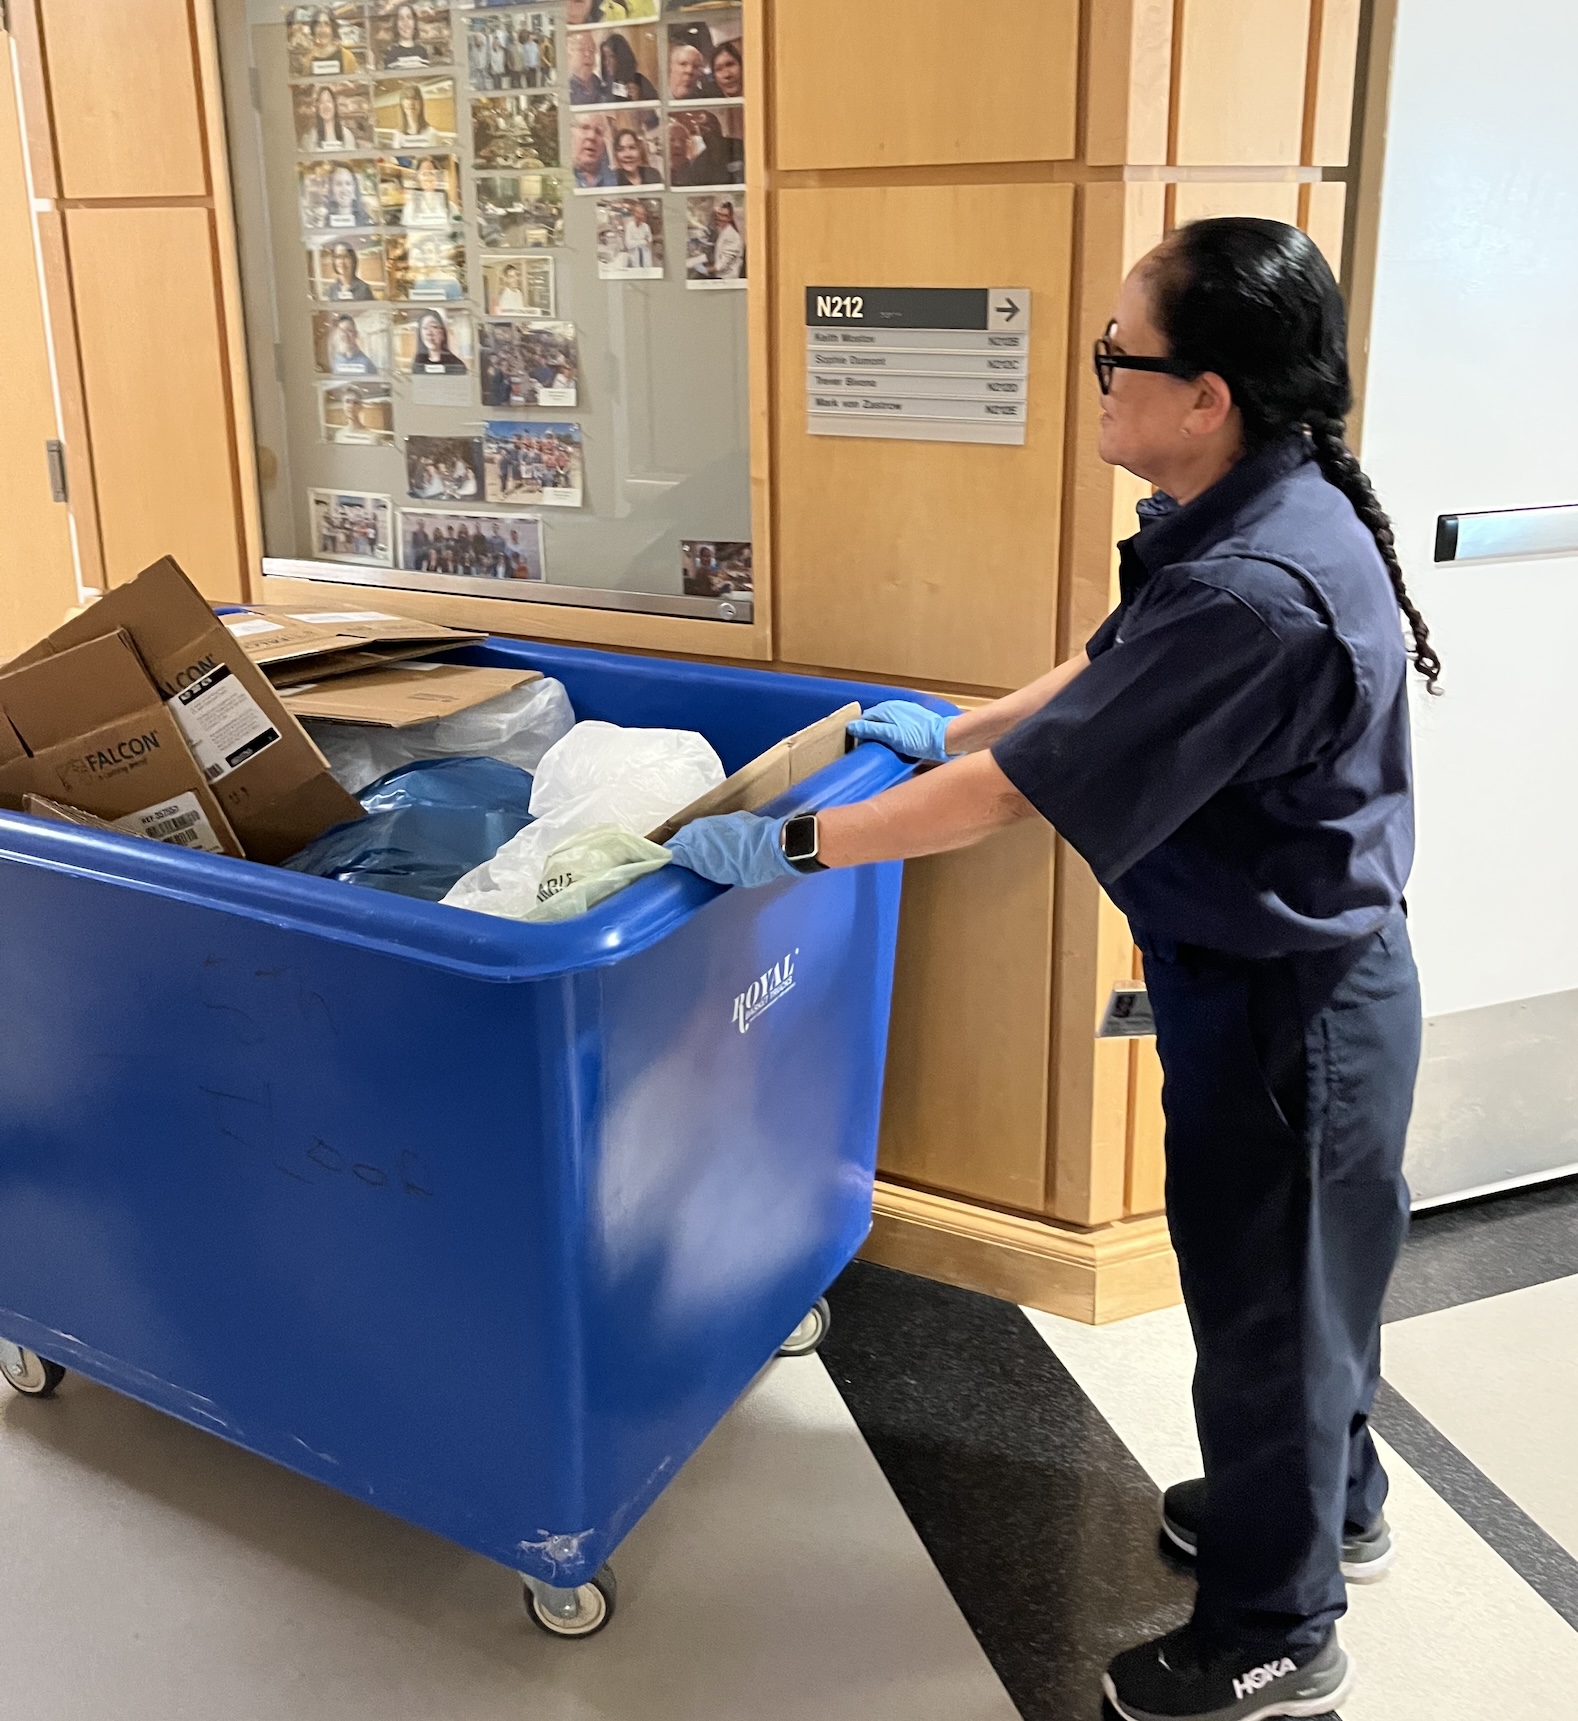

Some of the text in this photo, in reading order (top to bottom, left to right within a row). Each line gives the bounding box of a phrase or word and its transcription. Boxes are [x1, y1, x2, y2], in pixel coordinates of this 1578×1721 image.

[816, 295, 864, 318] N212
[84, 731, 160, 772] FALCON
[731, 953, 796, 1034] ROYAL
[1232, 1657, 1298, 1700] HOKA
